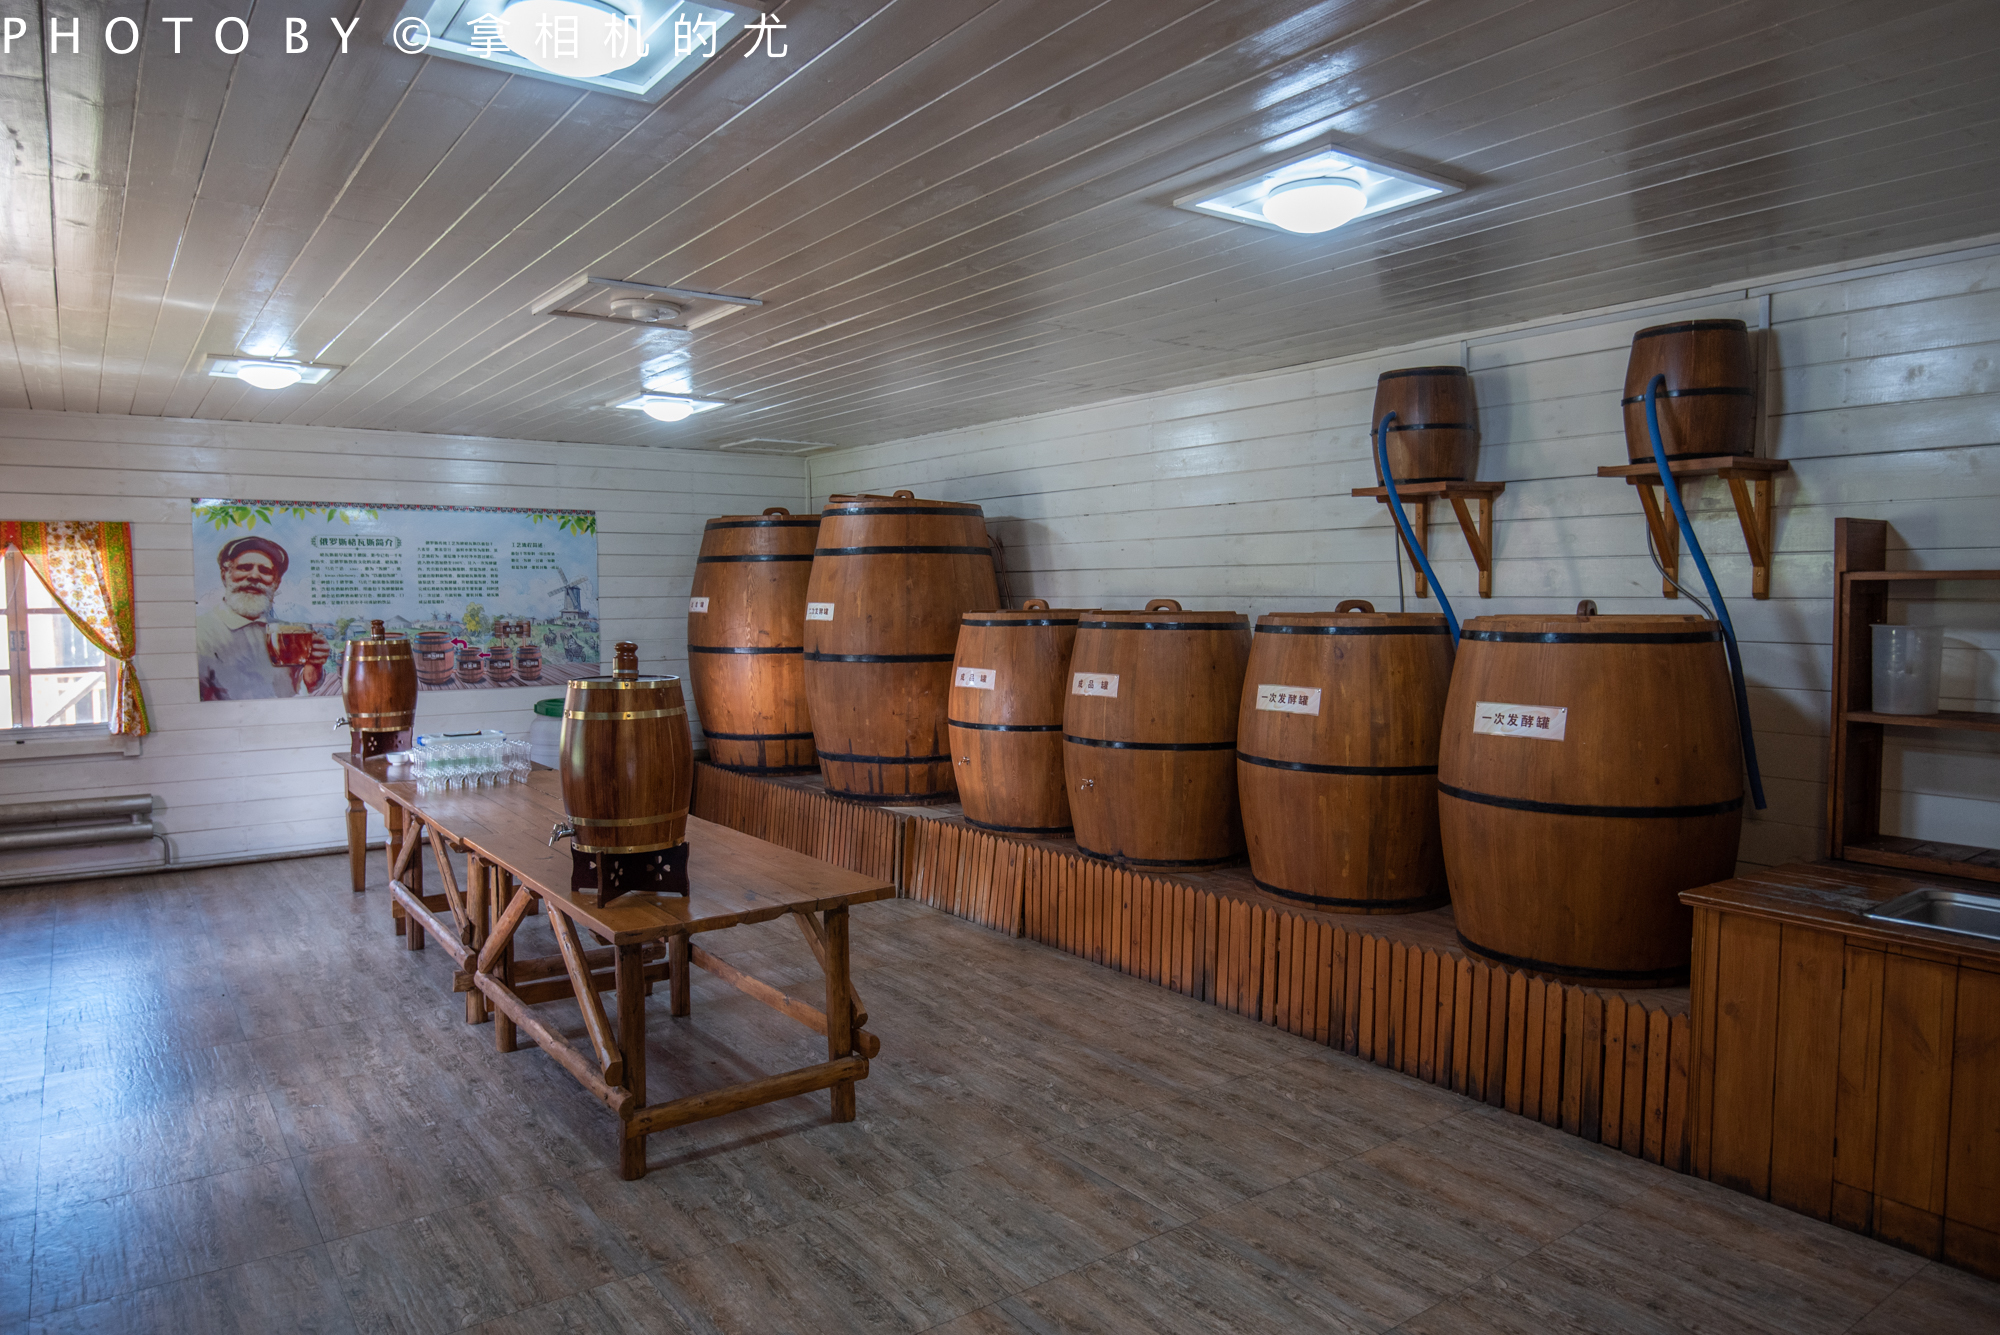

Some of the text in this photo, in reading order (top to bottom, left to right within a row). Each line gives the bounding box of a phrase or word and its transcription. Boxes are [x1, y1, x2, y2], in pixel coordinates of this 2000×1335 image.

[319, 537, 393, 547] 俄罗斯格瓦斯简介
[1261, 692, 1310, 706] 一次发酵罐
[1481, 712, 1551, 730] 一次发酵罐
